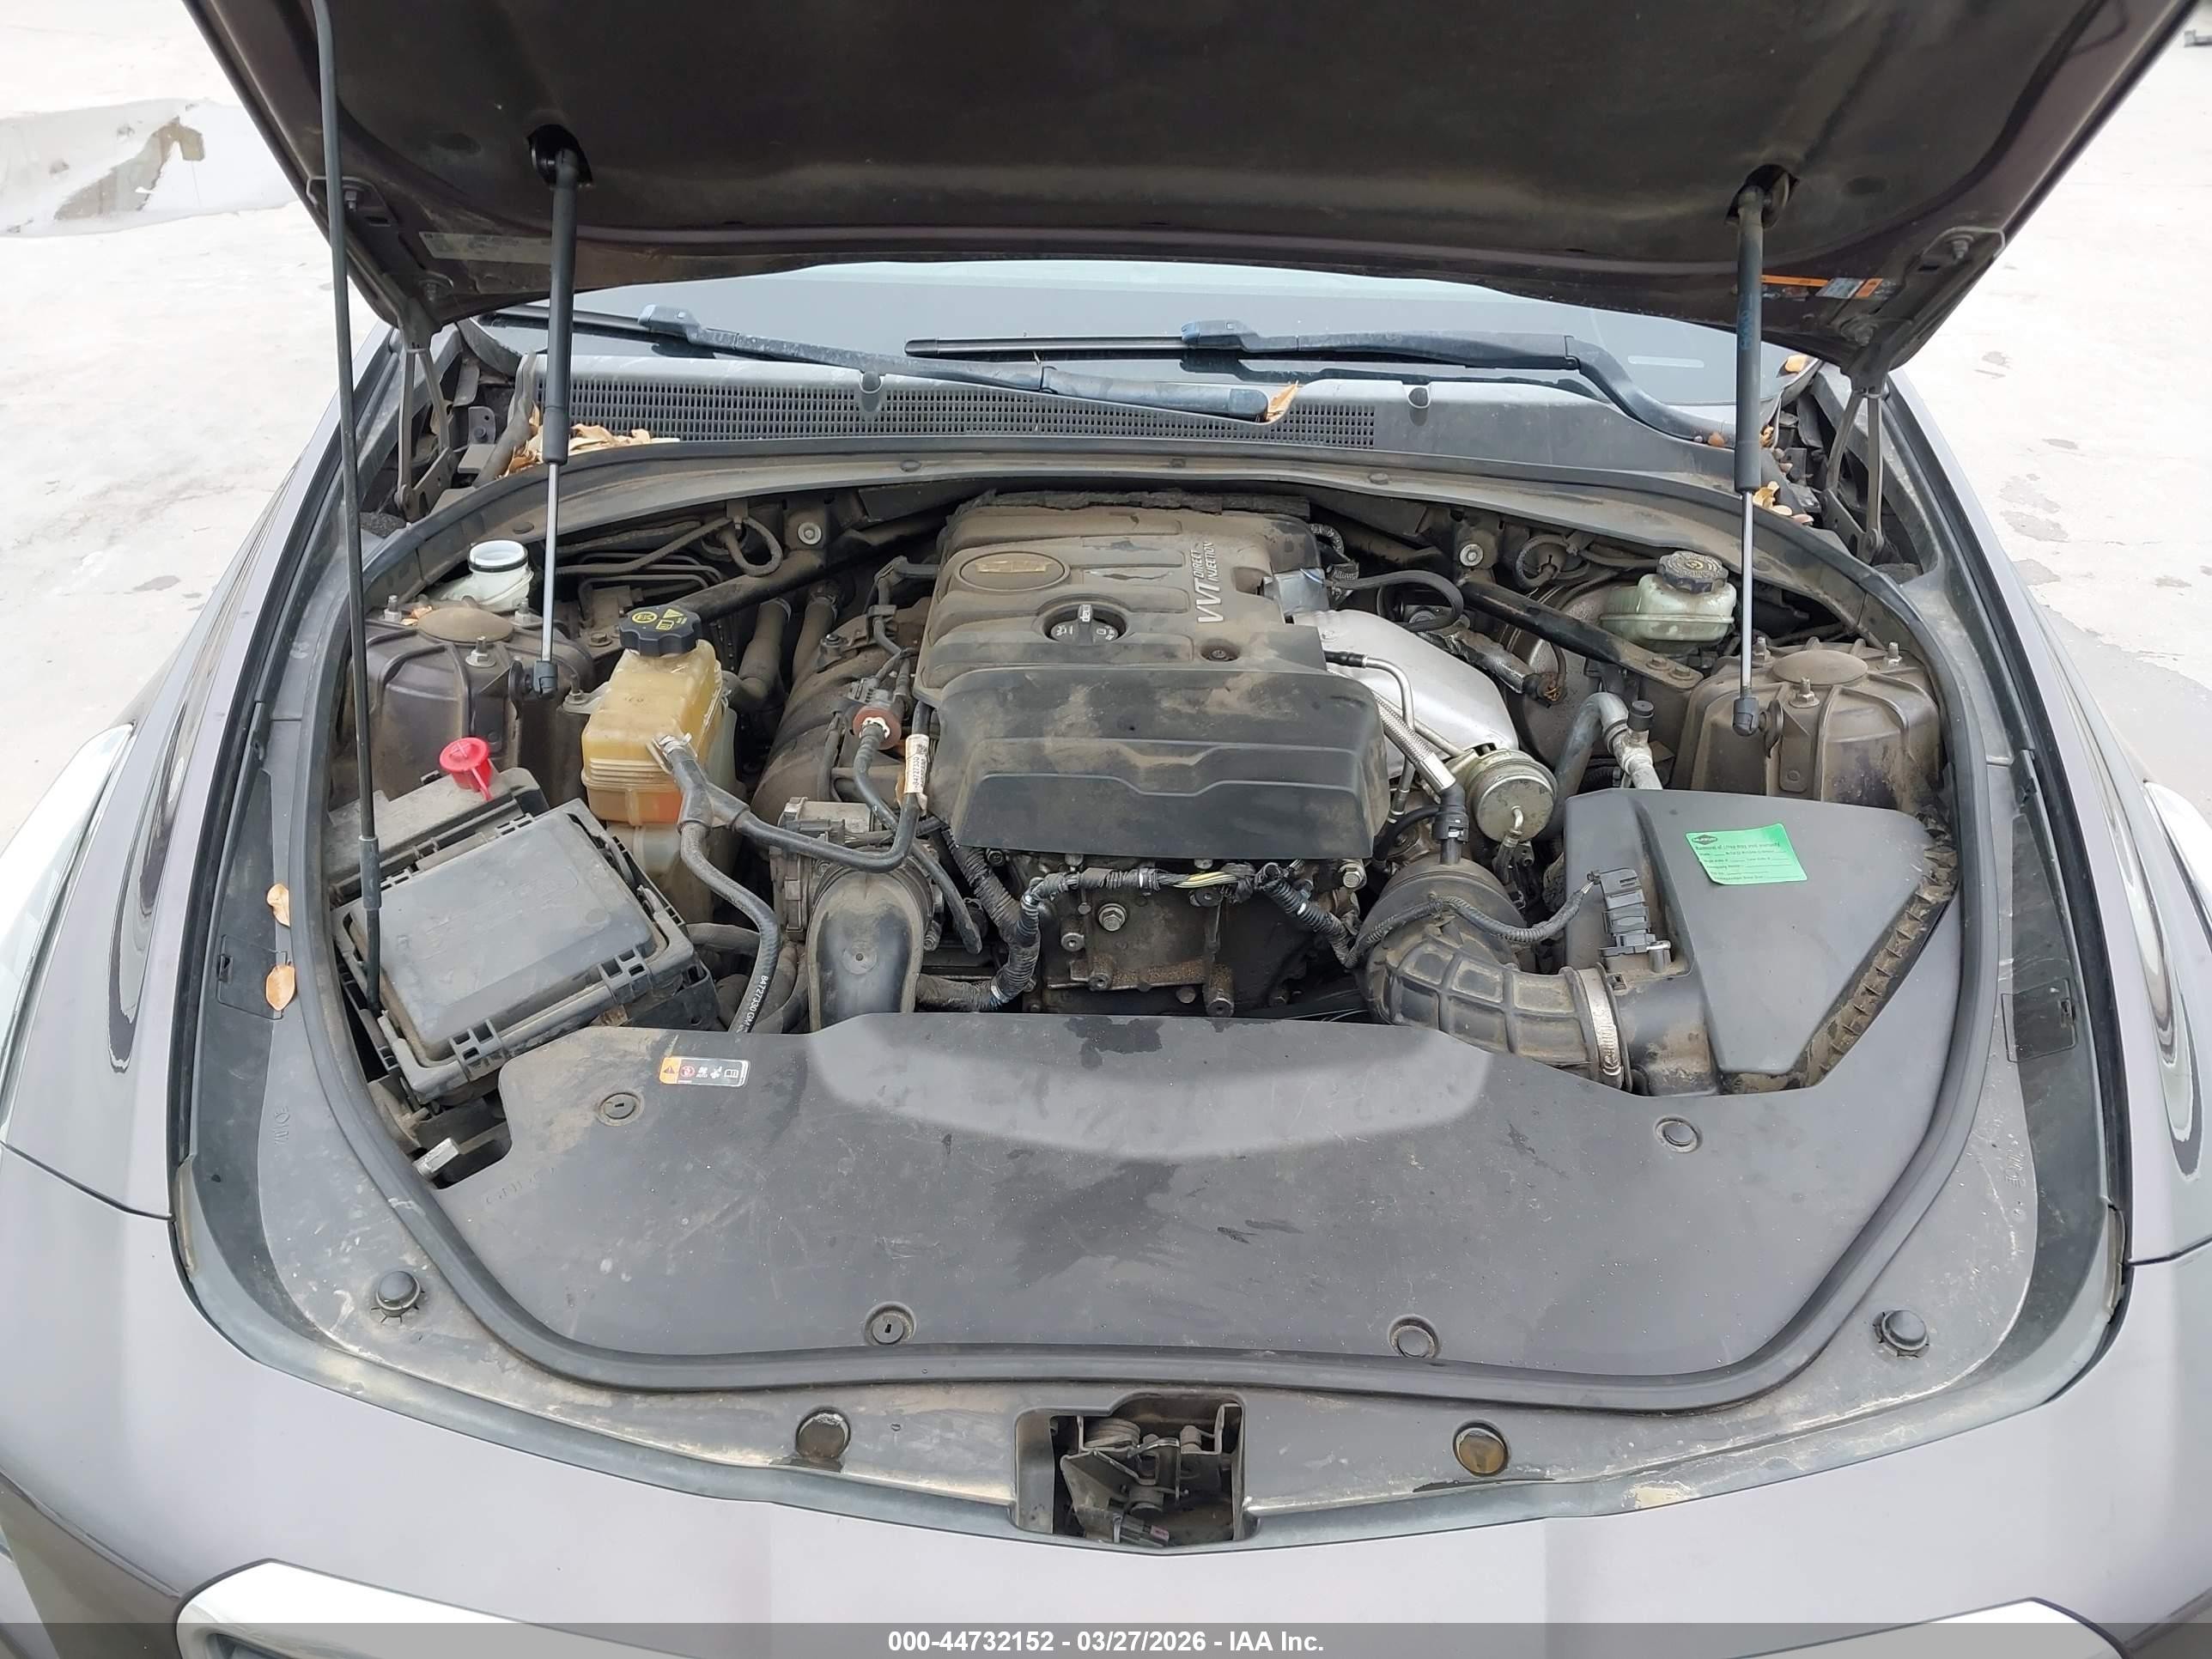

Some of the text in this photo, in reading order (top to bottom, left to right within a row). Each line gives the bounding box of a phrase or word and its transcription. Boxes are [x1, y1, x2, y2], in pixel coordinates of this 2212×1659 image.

[1191, 549, 1204, 578] DIRECT
[1203, 541, 1219, 581] INJECTION
[1194, 578, 1224, 623] VVT
[749, 975, 769, 1012] 84727330
